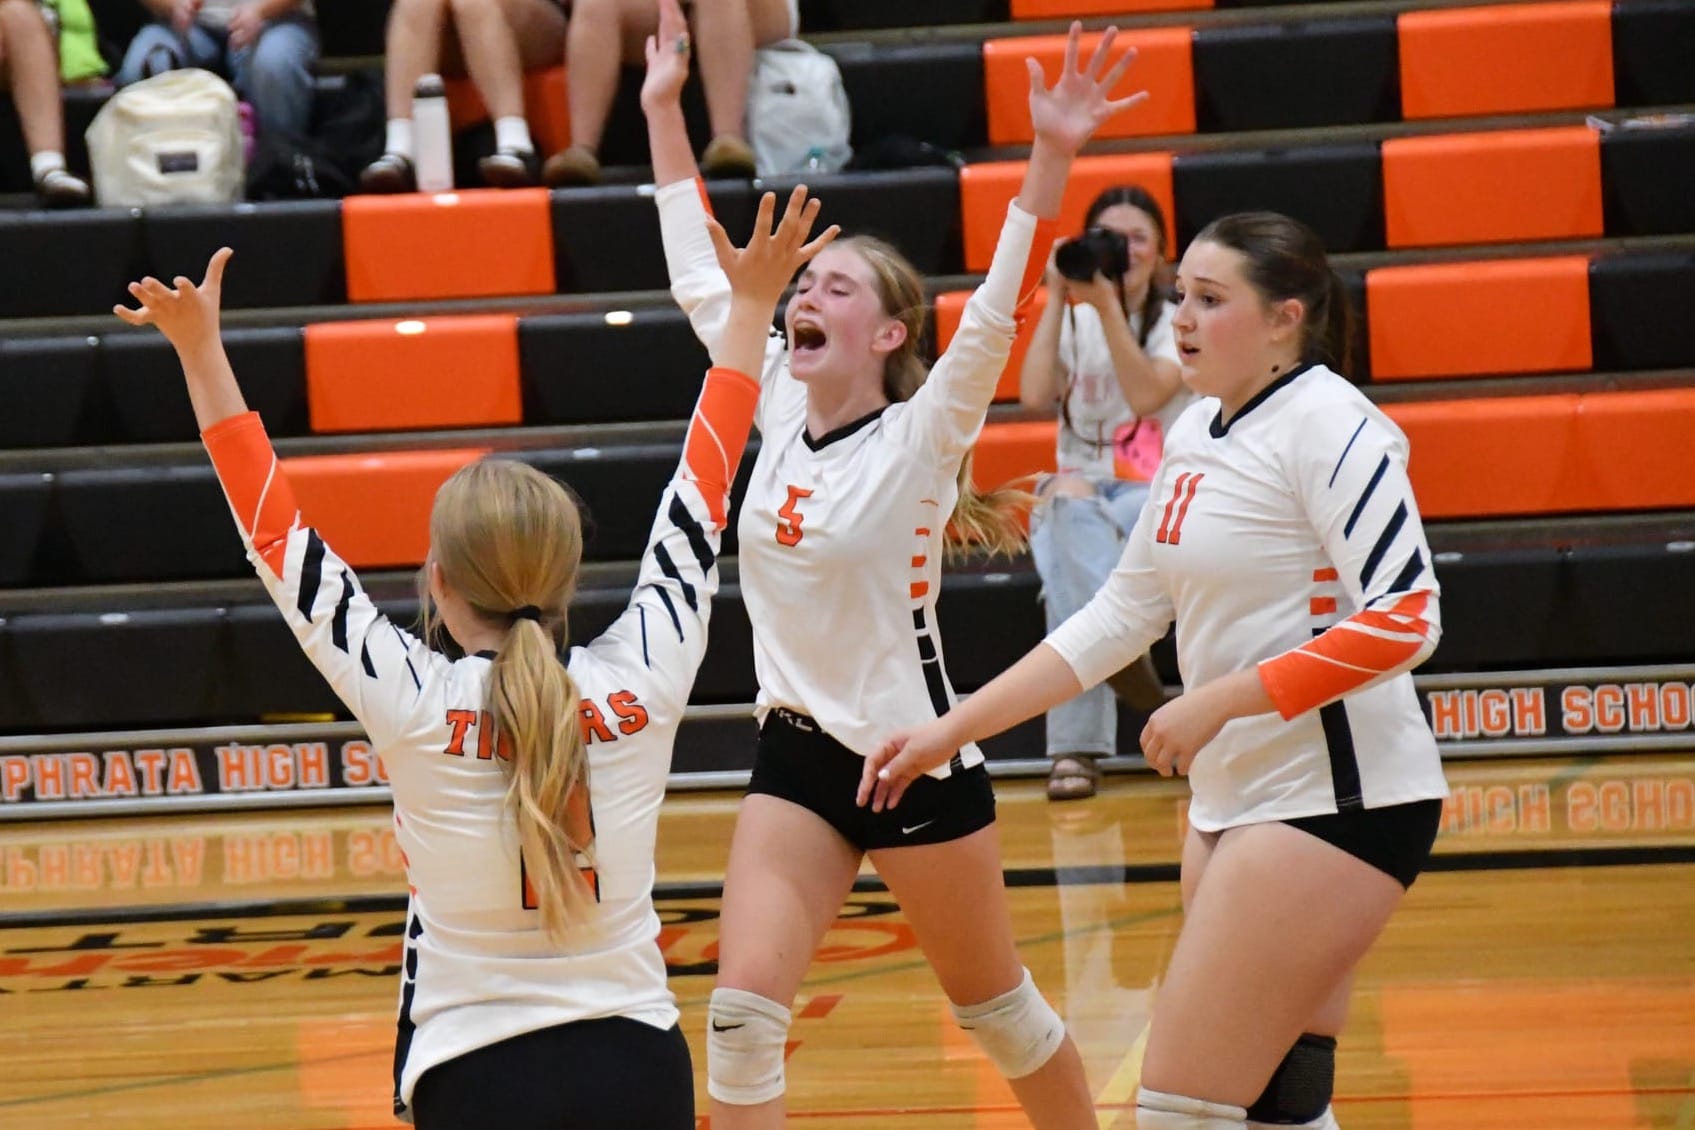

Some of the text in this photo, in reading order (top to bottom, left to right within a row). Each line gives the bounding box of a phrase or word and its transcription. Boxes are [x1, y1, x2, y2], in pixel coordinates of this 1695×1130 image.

[775, 484, 815, 547] 5
[1156, 472, 1205, 545] 11
[444, 690, 649, 762] TIRS
[1428, 682, 1695, 739] HIGH SCHO
[0, 749, 203, 800] PHRATA
[215, 742, 330, 793] HIGH
